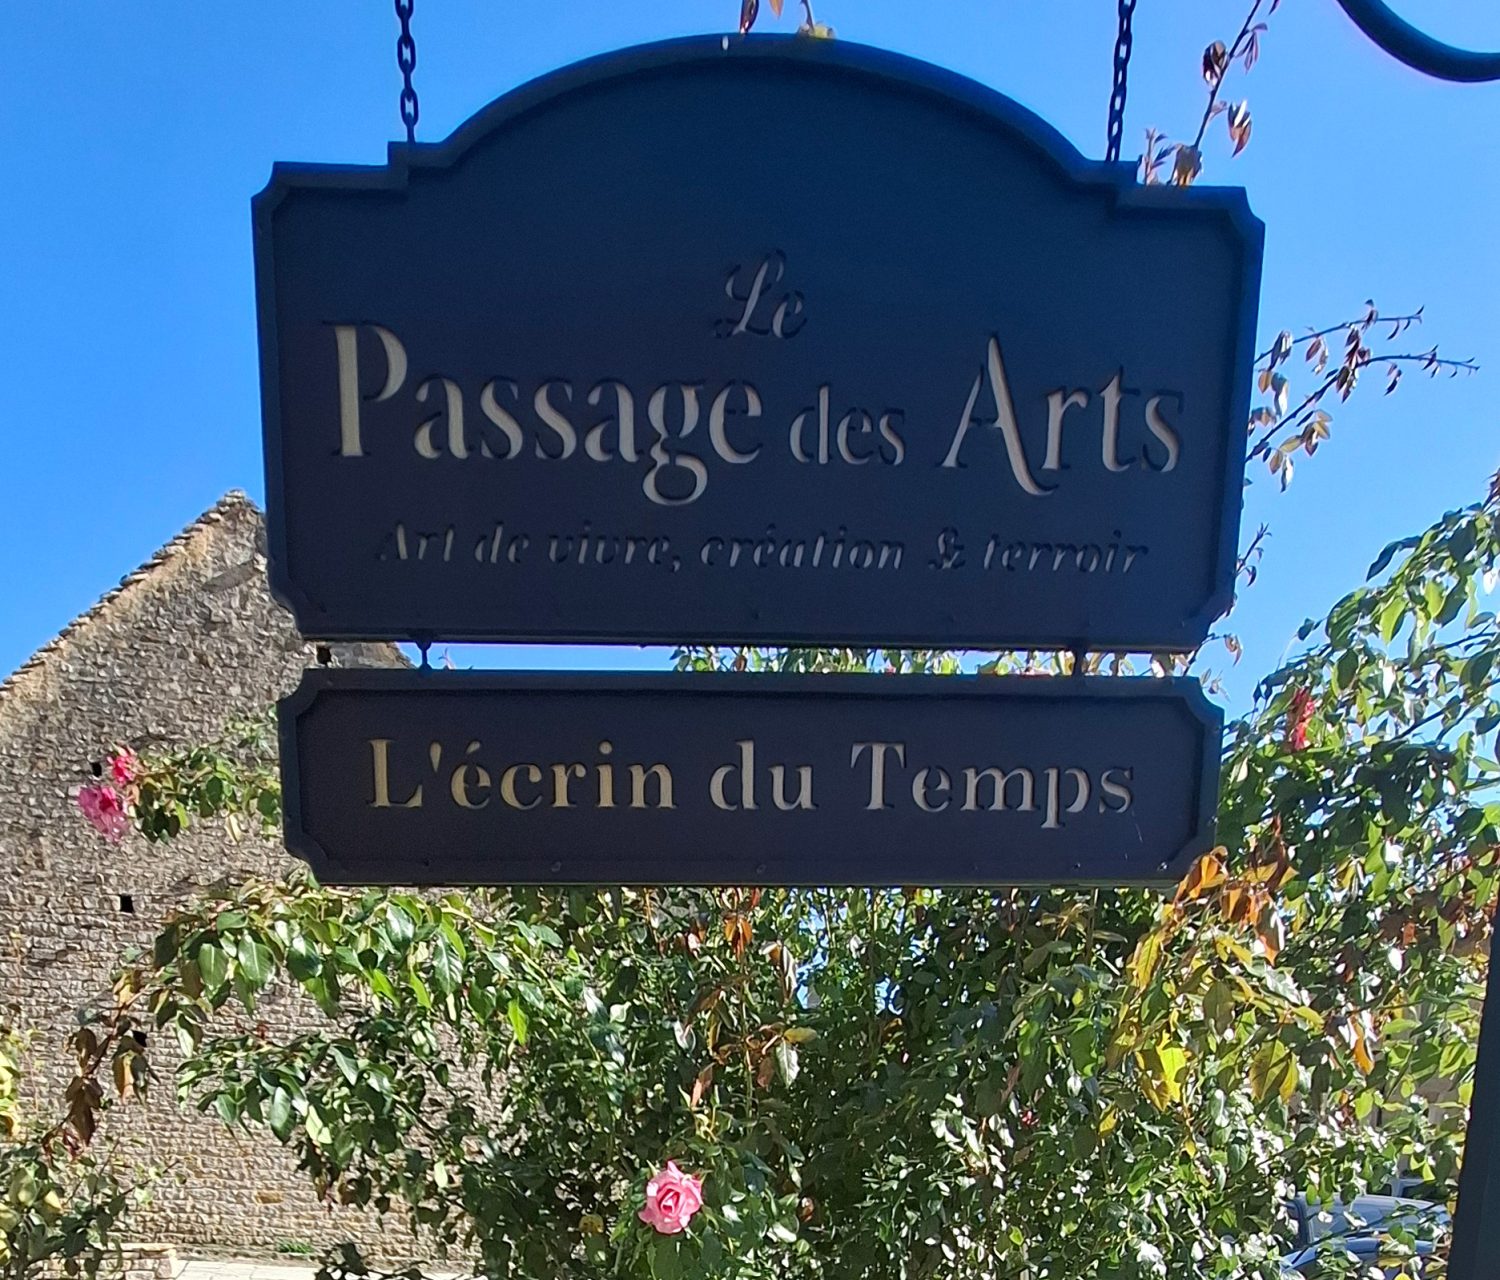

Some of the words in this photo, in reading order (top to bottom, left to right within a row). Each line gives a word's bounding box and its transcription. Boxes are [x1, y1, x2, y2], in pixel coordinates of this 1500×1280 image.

[714, 249, 808, 339] Le
[323, 320, 764, 506] Passage
[789, 382, 906, 466] des
[936, 331, 1184, 496] Arts
[376, 520, 456, 562] Art
[474, 520, 530, 565] de
[548, 520, 680, 573] vivre,
[700, 522, 904, 570] création
[928, 526, 966, 571] &
[983, 530, 1149, 573] terroir
[366, 738, 677, 812] L'écrin
[708, 740, 818, 813] du
[849, 741, 1135, 829] Temps
